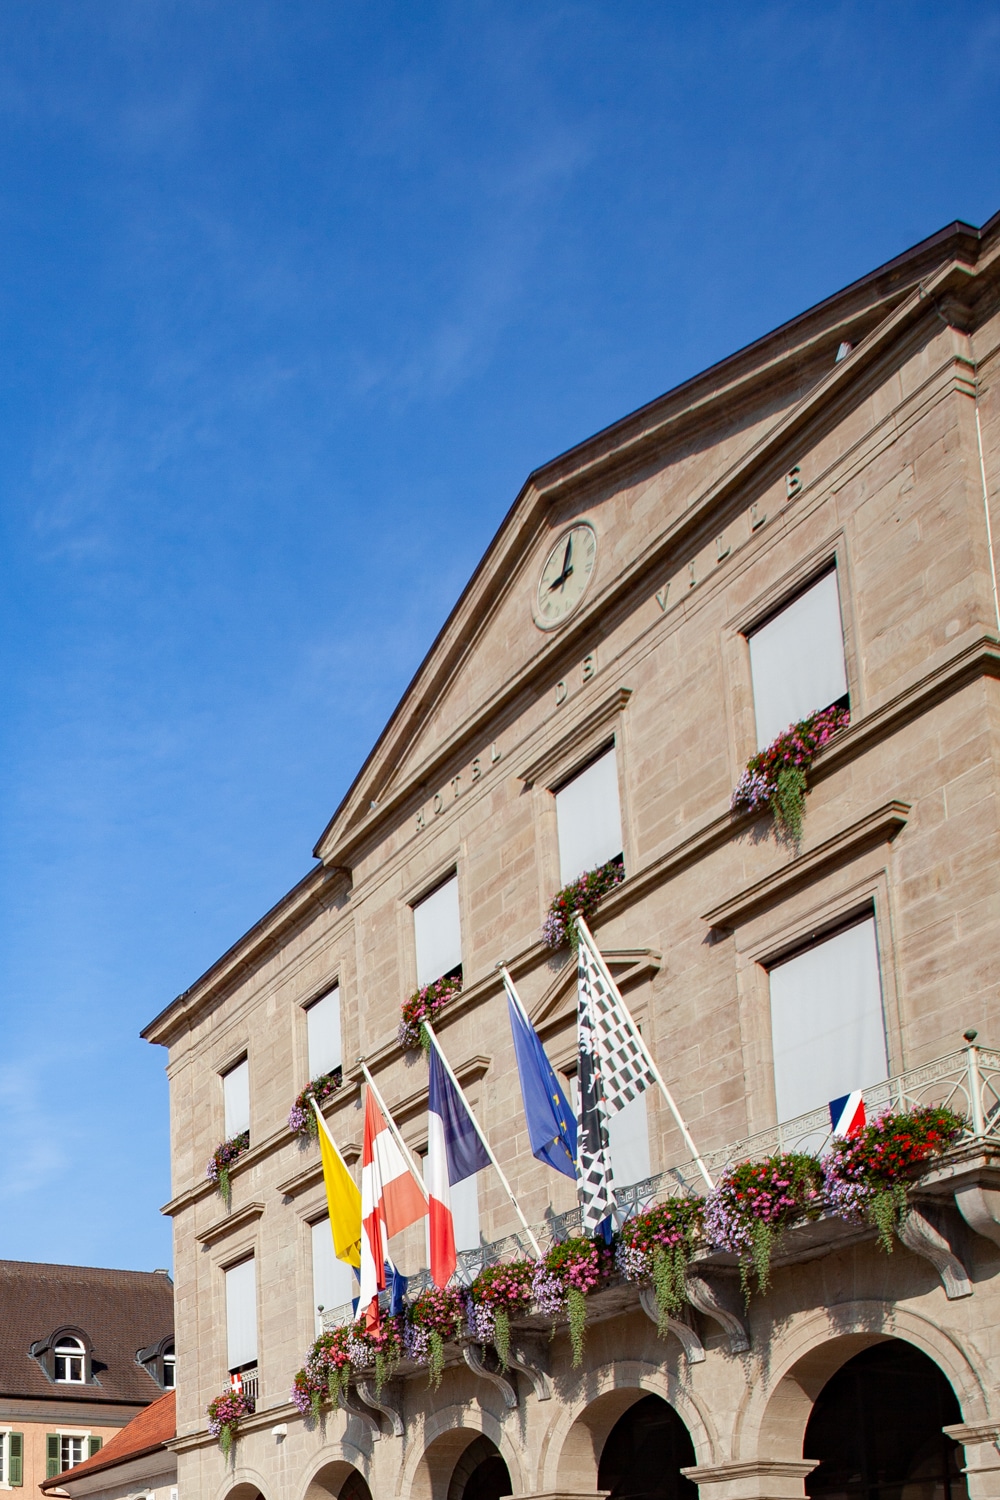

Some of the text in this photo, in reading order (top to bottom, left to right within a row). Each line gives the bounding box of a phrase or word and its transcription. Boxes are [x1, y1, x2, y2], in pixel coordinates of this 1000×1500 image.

[416, 742, 501, 832] HOTEL
[555, 655, 594, 707] DE
[655, 465, 802, 612] VILLE
